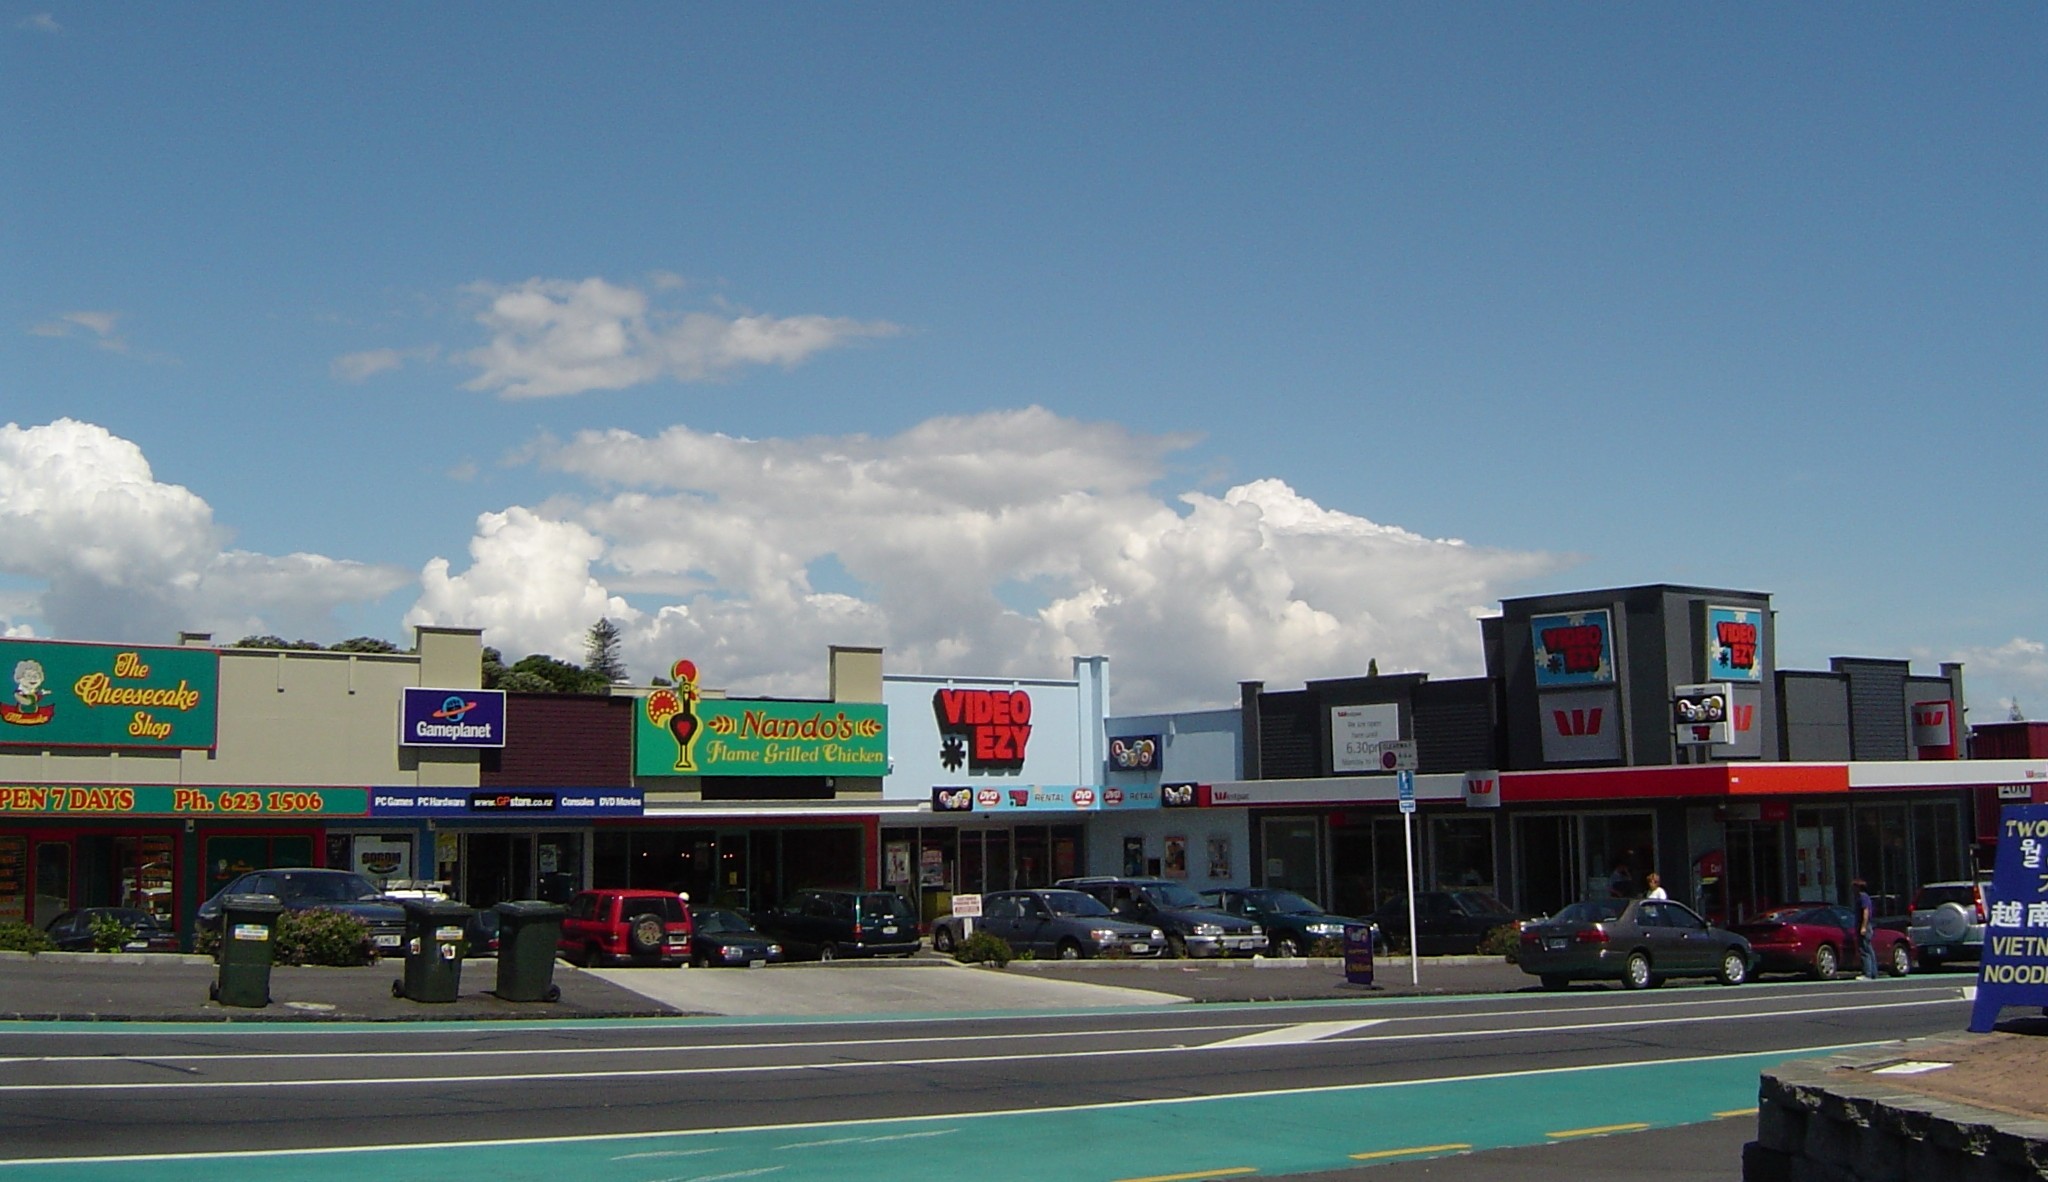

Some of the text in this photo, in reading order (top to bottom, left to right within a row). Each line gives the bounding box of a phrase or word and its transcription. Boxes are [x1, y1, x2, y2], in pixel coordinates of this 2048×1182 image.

[1541, 624, 1602, 650] VIDEO
[1717, 621, 1757, 644] VIDEO
[114, 652, 149, 678] The
[1564, 646, 1602, 672] EZY
[1730, 643, 1757, 668] EZY
[74, 672, 199, 710] Cheesecake
[939, 689, 1032, 725] VIDEO
[129, 711, 172, 739] Shop
[416, 721, 492, 740] Gameplanet
[740, 710, 853, 740] Nando's
[706, 740, 884, 764] Flame Grilled Chicken
[976, 725, 1032, 760] EZY
[1346, 741, 1379, 754] 6.30p
[51, 788, 66, 810] 7
[68, 788, 134, 810] DAYS
[174, 789, 323, 811] Ph. 623 1506
[375, 797, 414, 807] PC Games
[418, 797, 429, 807] PC
[561, 797, 595, 807] Consoles
[600, 797, 615, 807] DVD
[1035, 793, 1064, 802] RENTAL
[2006, 821, 2048, 837] TWO
